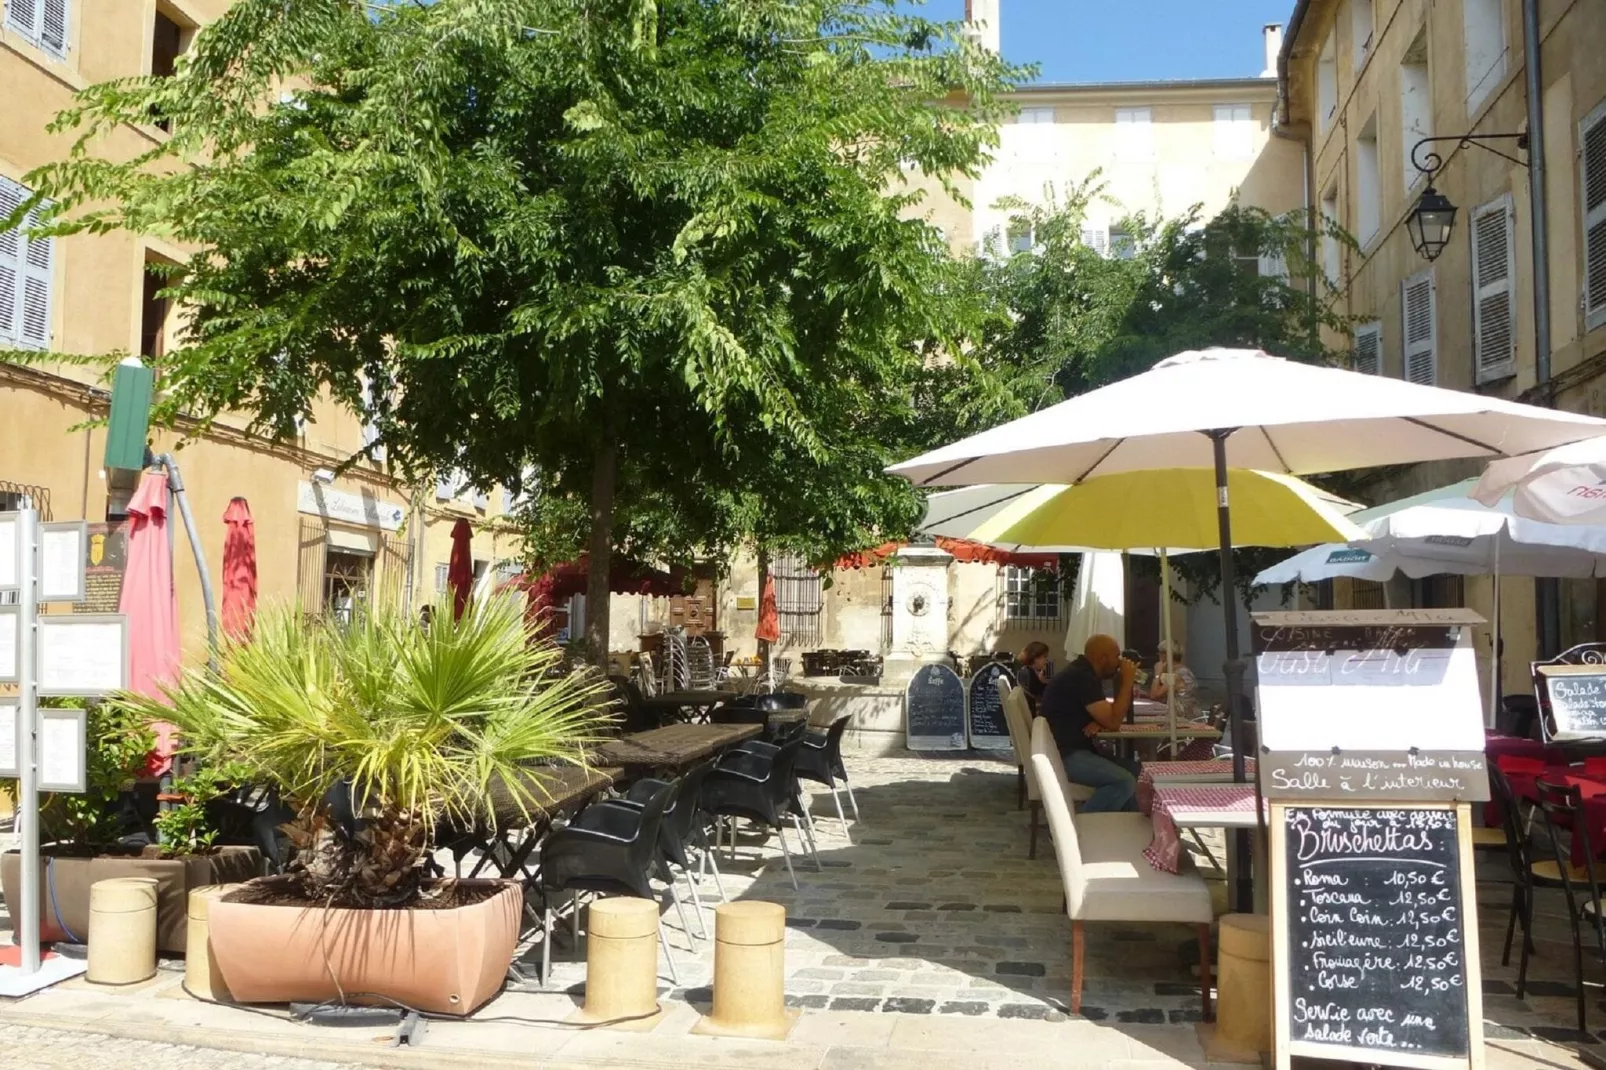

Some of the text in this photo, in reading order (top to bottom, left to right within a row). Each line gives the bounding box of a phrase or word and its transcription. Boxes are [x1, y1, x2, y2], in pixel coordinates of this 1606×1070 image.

[927, 676, 944, 686] Leffe
[1554, 681, 1602, 699] Salade
[1293, 753, 1335, 768] 100%
[1451, 756, 1483, 770] house
[1271, 769, 1331, 790] Salle
[1376, 810, 1407, 821] avec
[1322, 819, 1342, 829] du
[1349, 819, 1383, 833] jour
[1291, 817, 1434, 860] Bruschettas
[1303, 869, 1349, 886] Roma
[1310, 906, 1345, 924] Coin
[1318, 970, 1360, 990] Corse
[1293, 997, 1351, 1022] Servie
[1356, 1008, 1396, 1023] avec
